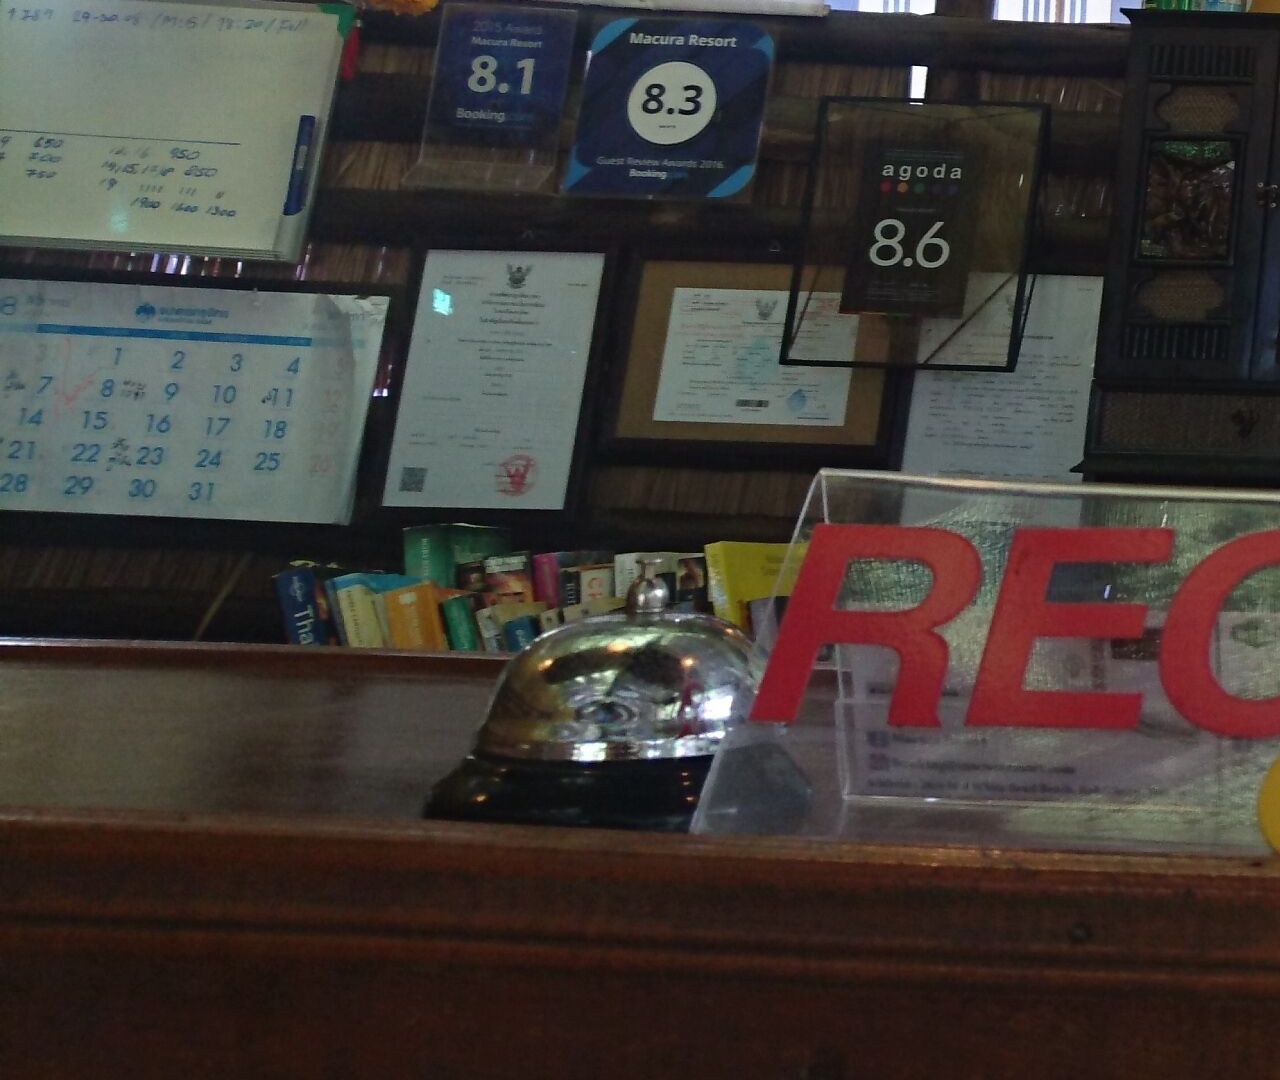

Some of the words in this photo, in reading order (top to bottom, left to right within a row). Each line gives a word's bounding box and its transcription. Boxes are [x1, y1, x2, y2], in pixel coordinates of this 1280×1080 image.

[472, 36, 508, 47] Macura
[629, 32, 686, 47] Macura
[689, 34, 738, 48] Resort
[467, 55, 536, 95] 8.1
[641, 83, 703, 116] 8.3
[882, 161, 962, 181] agoda
[868, 218, 951, 269] 8.6
[113, 347, 122, 366] 1
[172, 351, 186, 370] 2
[231, 354, 243, 371] 3
[287, 357, 299, 375] 4
[37, 377, 53, 394] 7
[101, 379, 115, 398] 8
[165, 382, 180, 400] 9
[213, 385, 237, 404] 10
[272, 388, 294, 407] 11
[19, 408, 43, 427] 14
[83, 411, 108, 430] 15
[147, 414, 171, 434] 16
[206, 417, 230, 437] 17
[264, 420, 287, 439] 18
[8, 440, 35, 460] 21
[71, 443, 100, 463] 22
[136, 446, 164, 466] 23
[195, 450, 222, 469] 24
[254, 452, 280, 471] 25
[0, 474, 28, 493] 28
[65, 476, 93, 496] 29
[129, 479, 156, 499] 30
[189, 482, 215, 501] 31
